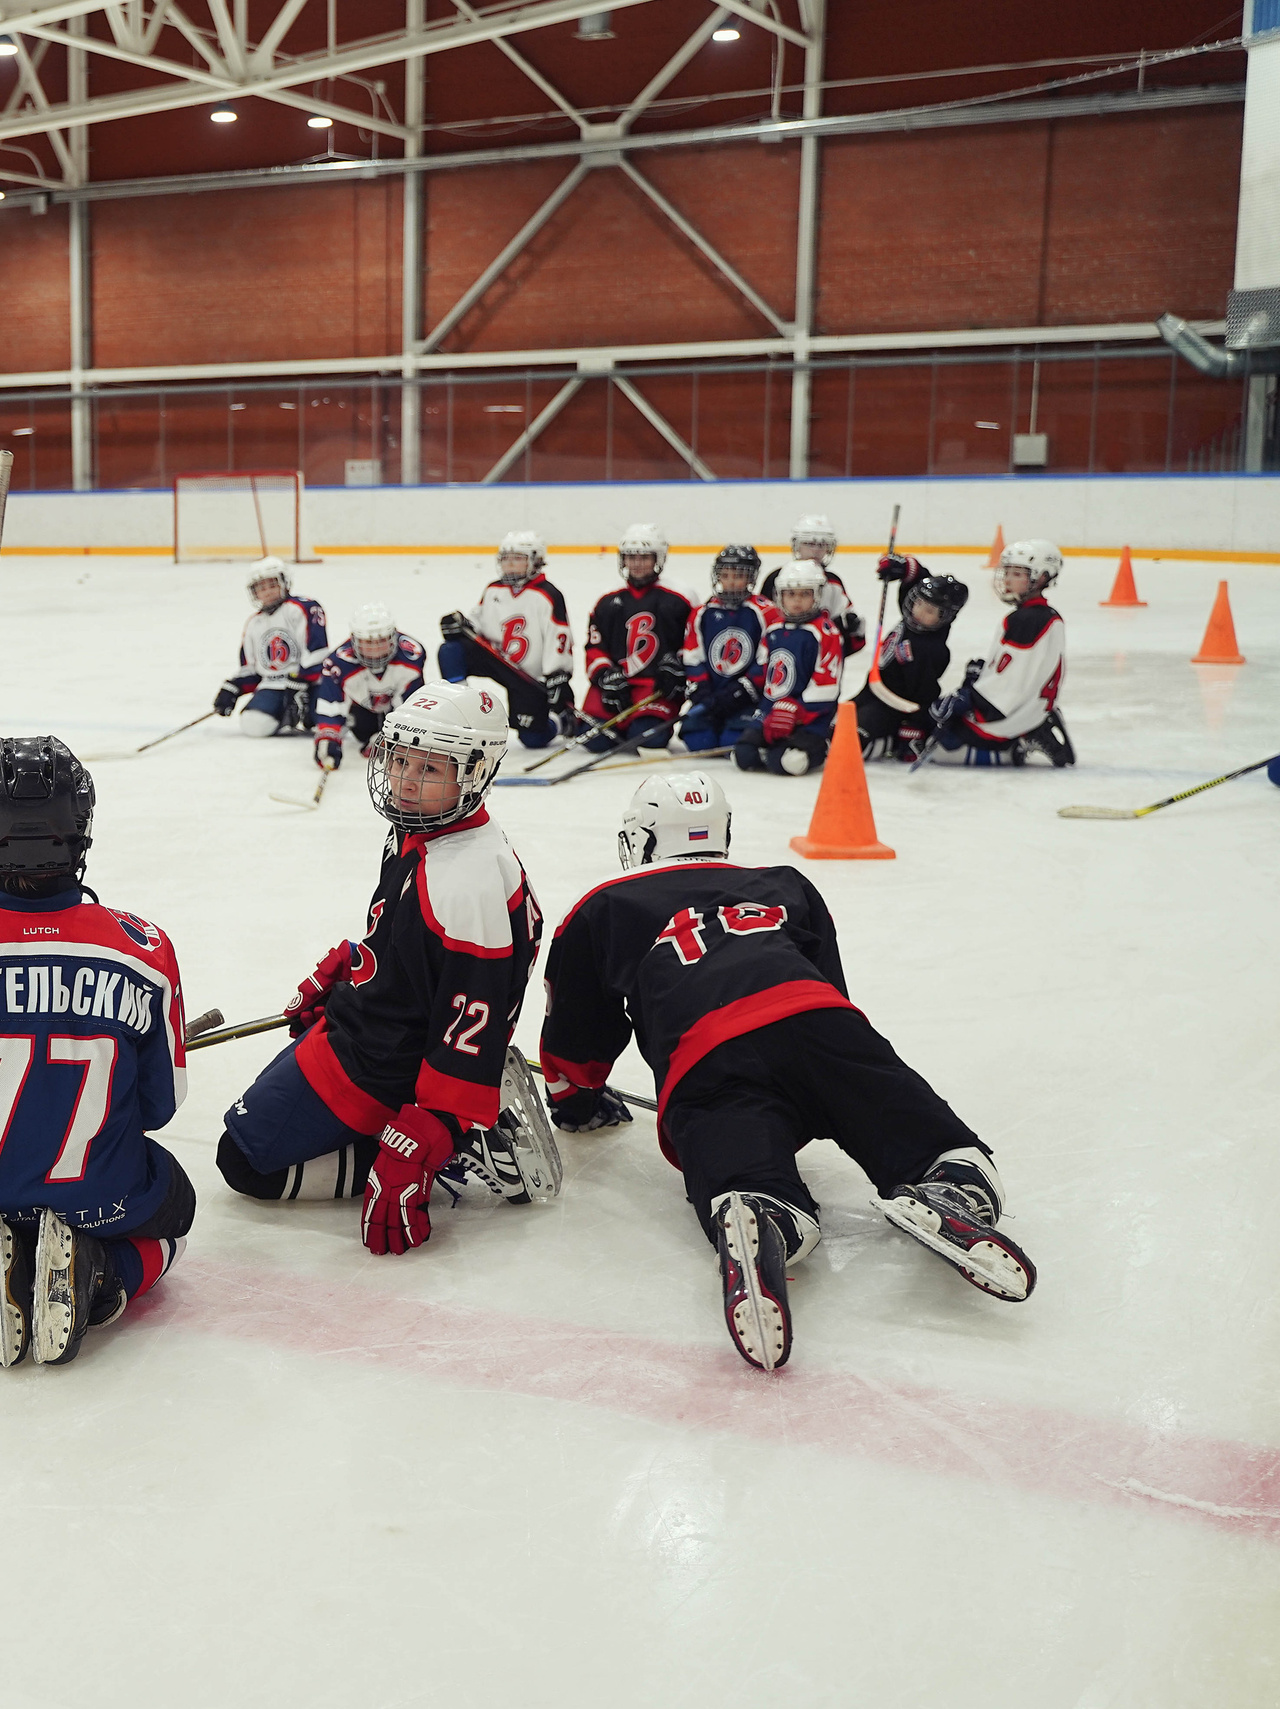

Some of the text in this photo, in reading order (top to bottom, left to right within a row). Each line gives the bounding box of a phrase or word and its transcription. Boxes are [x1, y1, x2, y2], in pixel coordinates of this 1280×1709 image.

[412, 698, 438, 711] 22
[684, 791, 703, 805] 40
[23, 927, 60, 935] LUTCH
[442, 992, 490, 1057] 22
